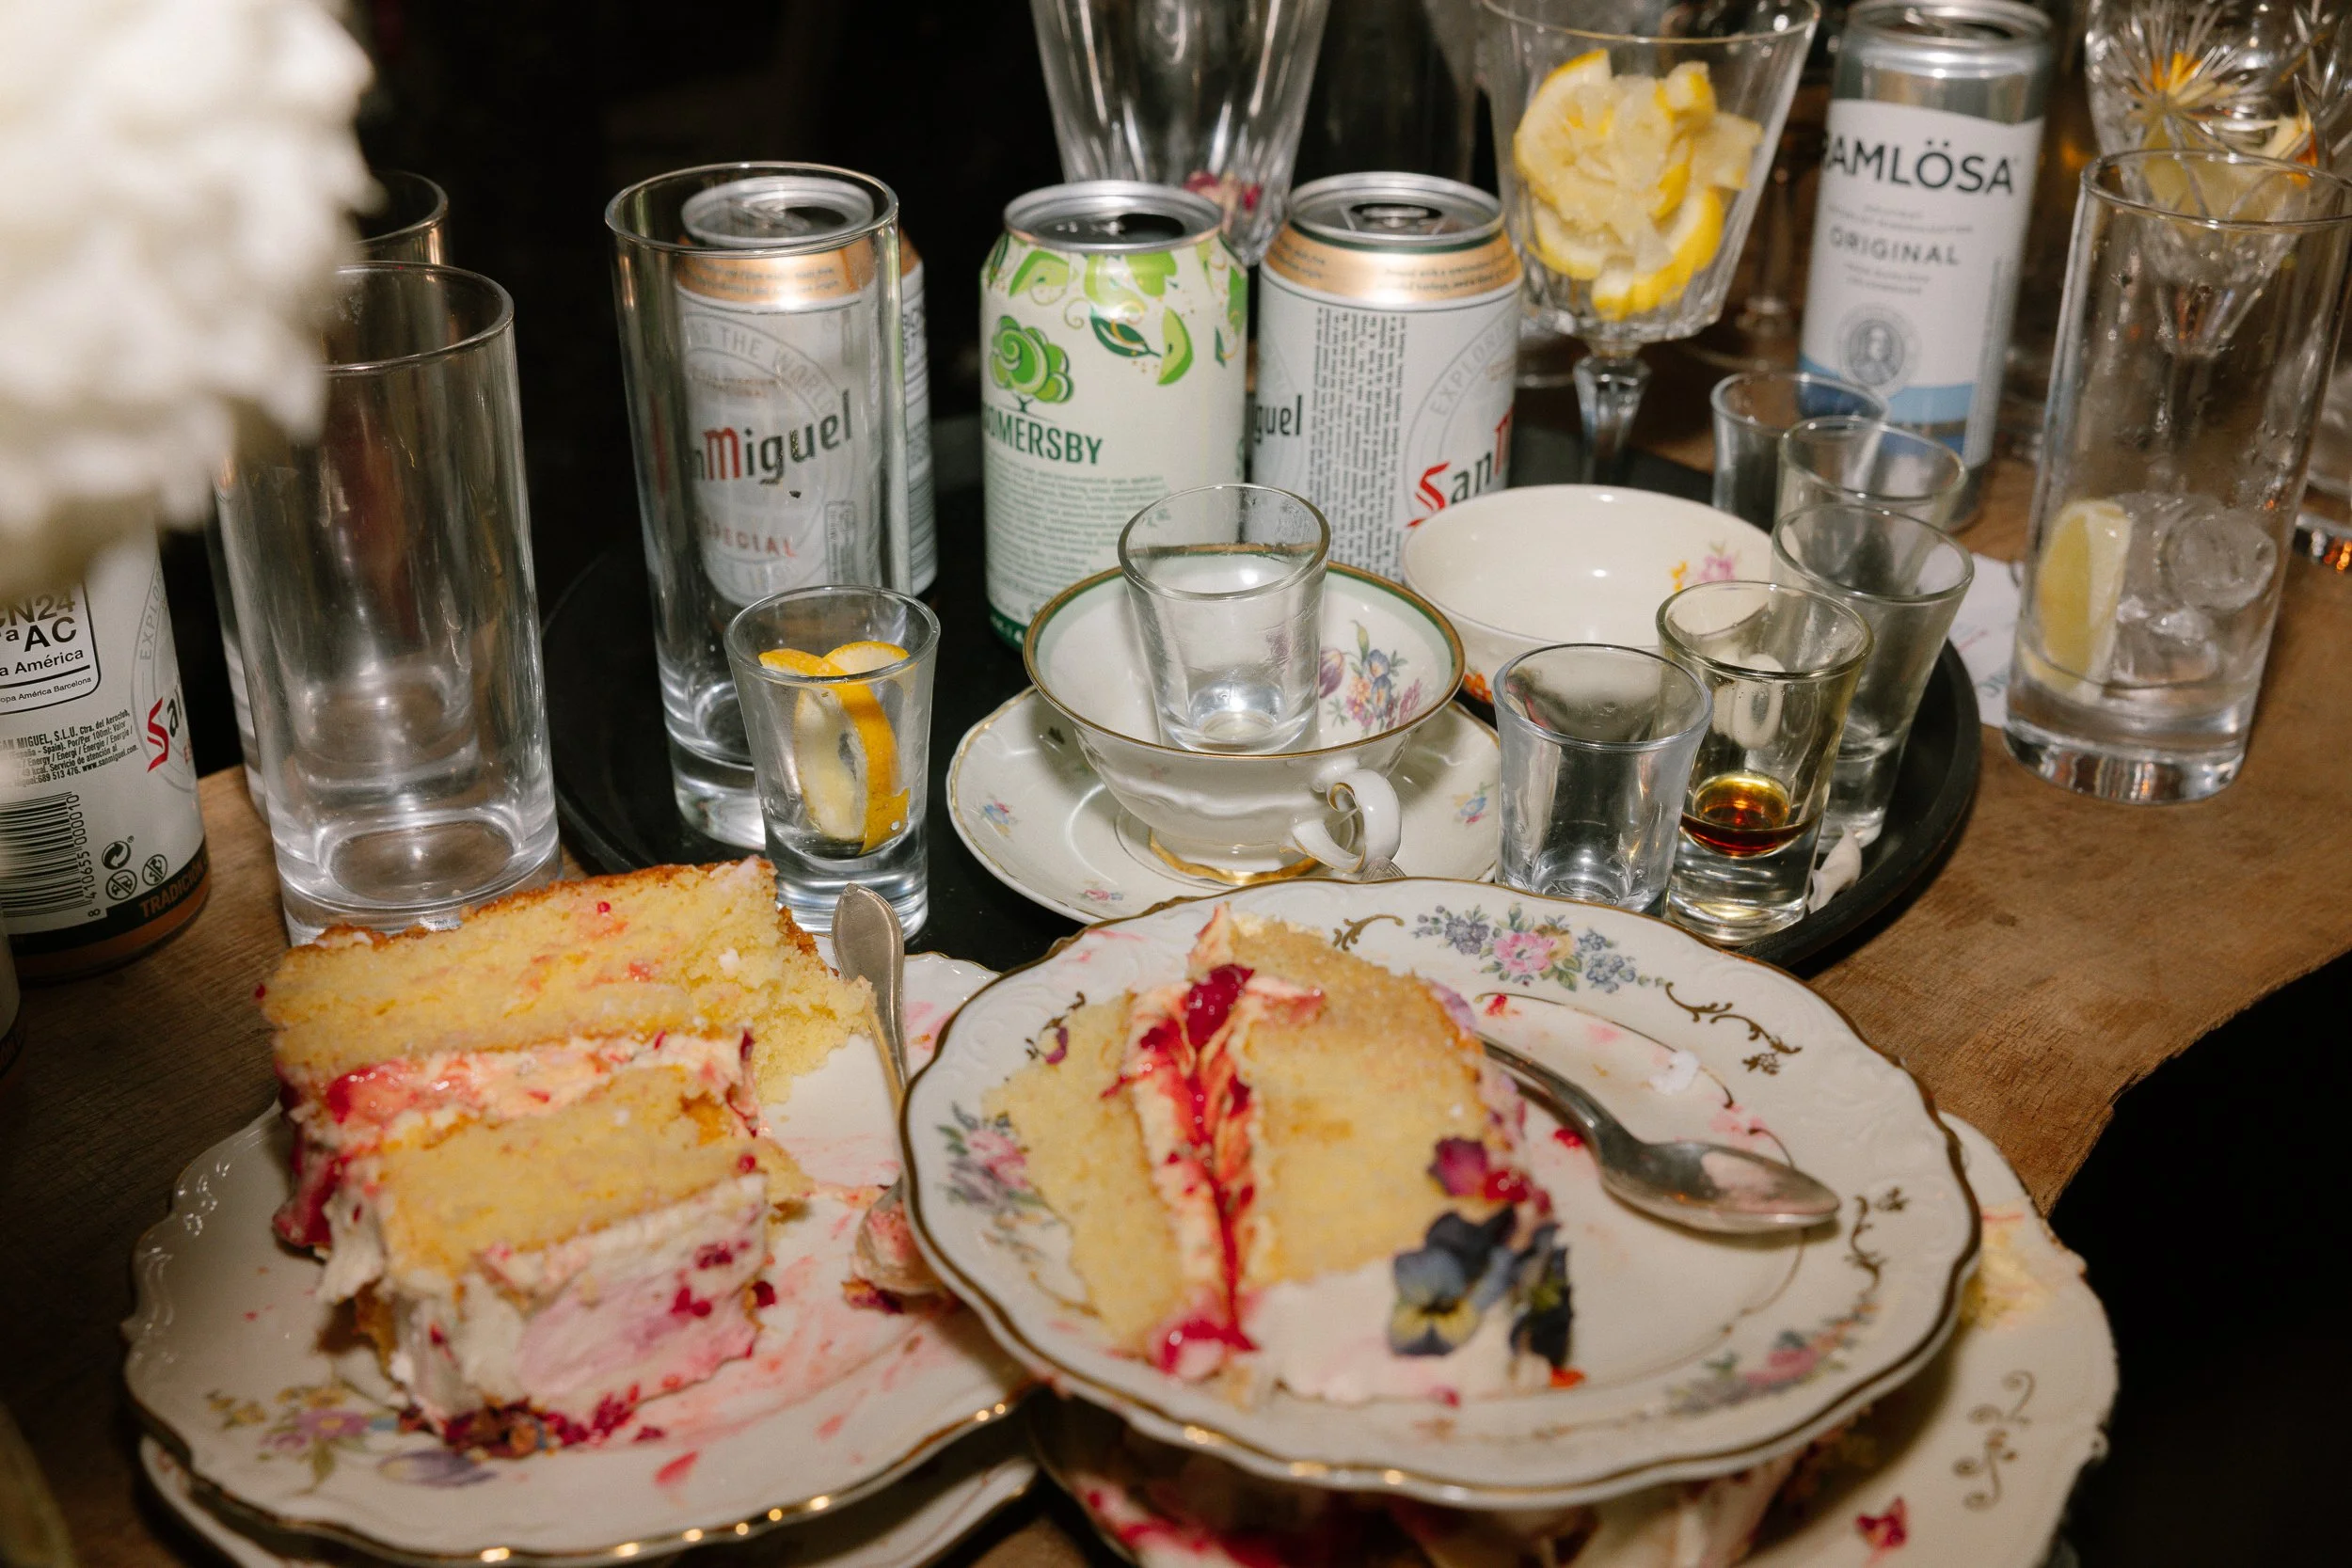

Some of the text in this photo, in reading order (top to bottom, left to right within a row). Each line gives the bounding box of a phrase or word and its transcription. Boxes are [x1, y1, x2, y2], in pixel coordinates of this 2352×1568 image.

[1829, 225, 1960, 265] ORIGINAL
[983, 404, 1103, 465] OMERSBY
[1253, 394, 1303, 444] guel
[0, 591, 75, 628] N24
[24, 616, 77, 652] AC
[15, 649, 84, 674] América
[19, 688, 53, 700] América
[54, 676, 91, 692] Barcelona
[17, 733, 53, 750] MIGUEL,
[54, 725, 78, 742] S.L.U.
[96, 719, 104, 730] del
[67, 735, 91, 748] Por/Per
[49, 757, 76, 772] Servicio
[76, 755, 86, 766] de
[86, 747, 111, 763] atención
[52, 768, 66, 781] 513
[66, 766, 81, 777] 476.
[66, 794, 101, 918] 8 410655 000010
